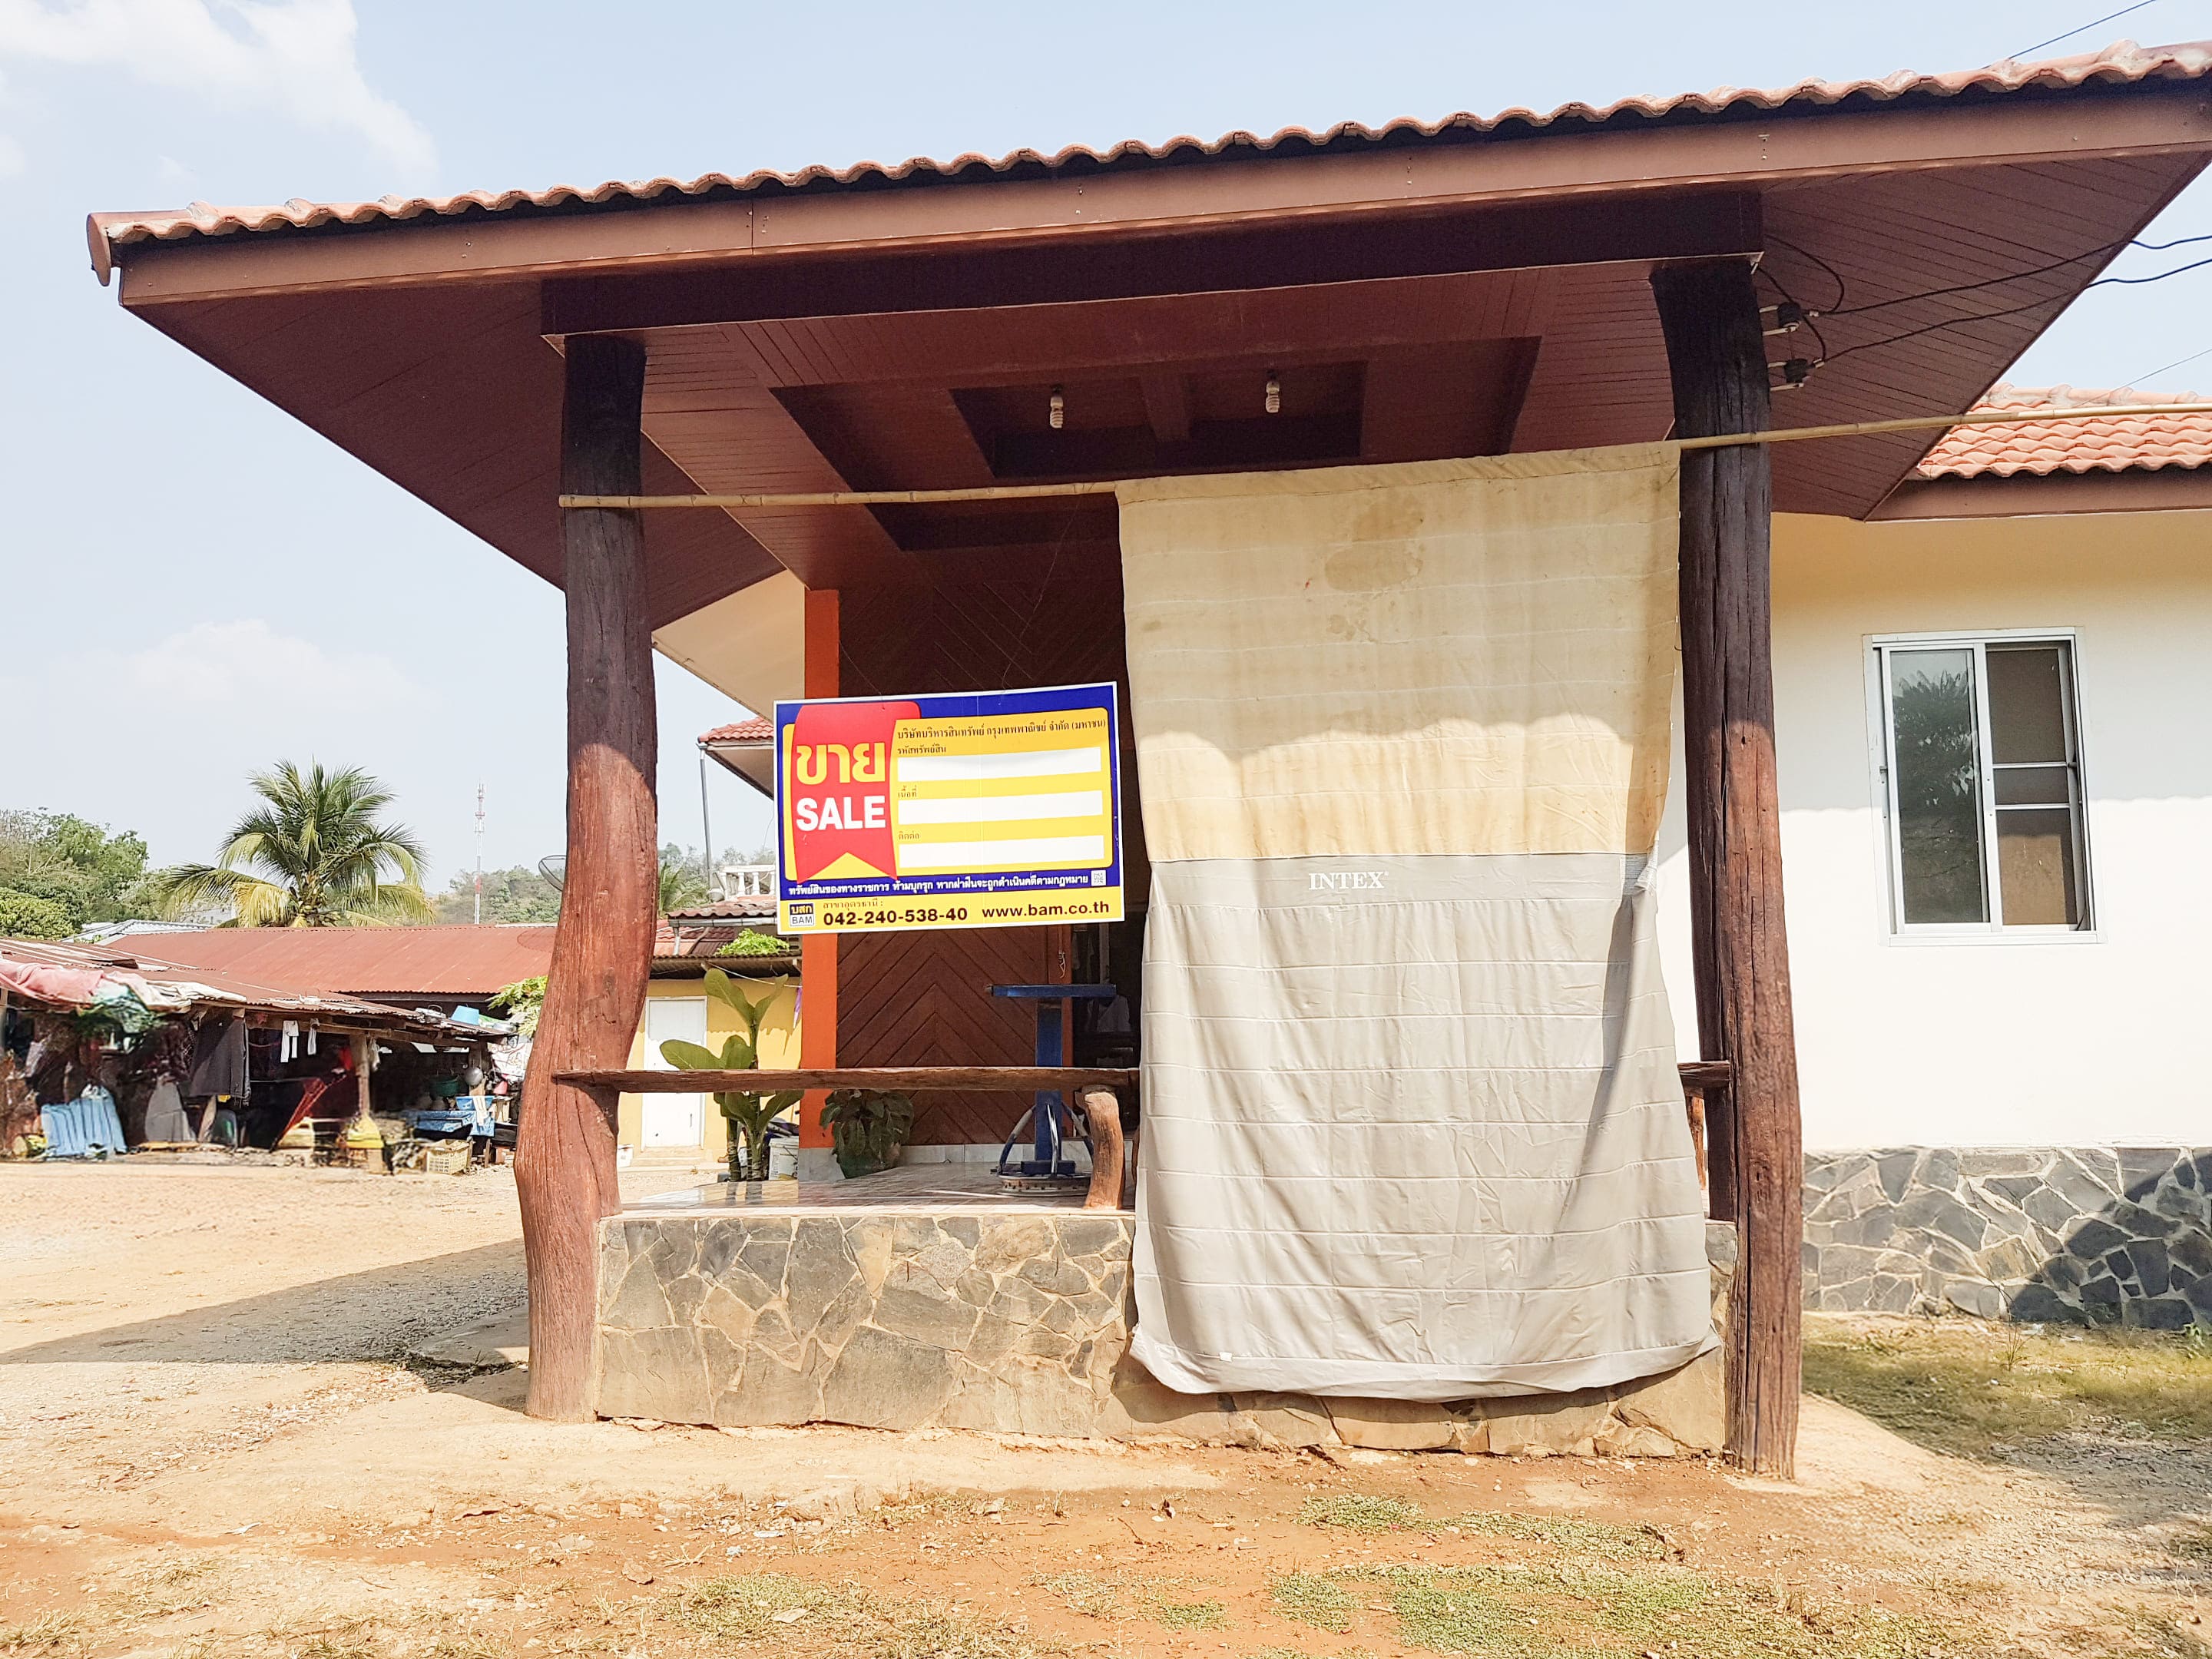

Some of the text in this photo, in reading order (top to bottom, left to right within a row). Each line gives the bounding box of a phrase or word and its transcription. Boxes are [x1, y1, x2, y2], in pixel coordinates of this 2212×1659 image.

[1049, 720, 1069, 731] จำกัด
[1071, 718, 1106, 730] (มหาชน)
[897, 743, 947, 755] รหัสทรัพย์สิน
[796, 741, 886, 785] ขาย
[897, 784, 918, 798] เนื้อที่
[796, 795, 886, 832] SALE
[898, 830, 920, 840] ติดต่อ
[788, 883, 890, 896] ทรัพย์สินของทางราชการ
[893, 880, 933, 893] ห้ามบุกรุก
[1308, 871, 1385, 890] INTEX
[791, 904, 813, 914] บสก
[823, 907, 968, 926] 042-240-538-40
[982, 901, 1109, 918] www.bam.co.th
[792, 916, 813, 925] BAM
